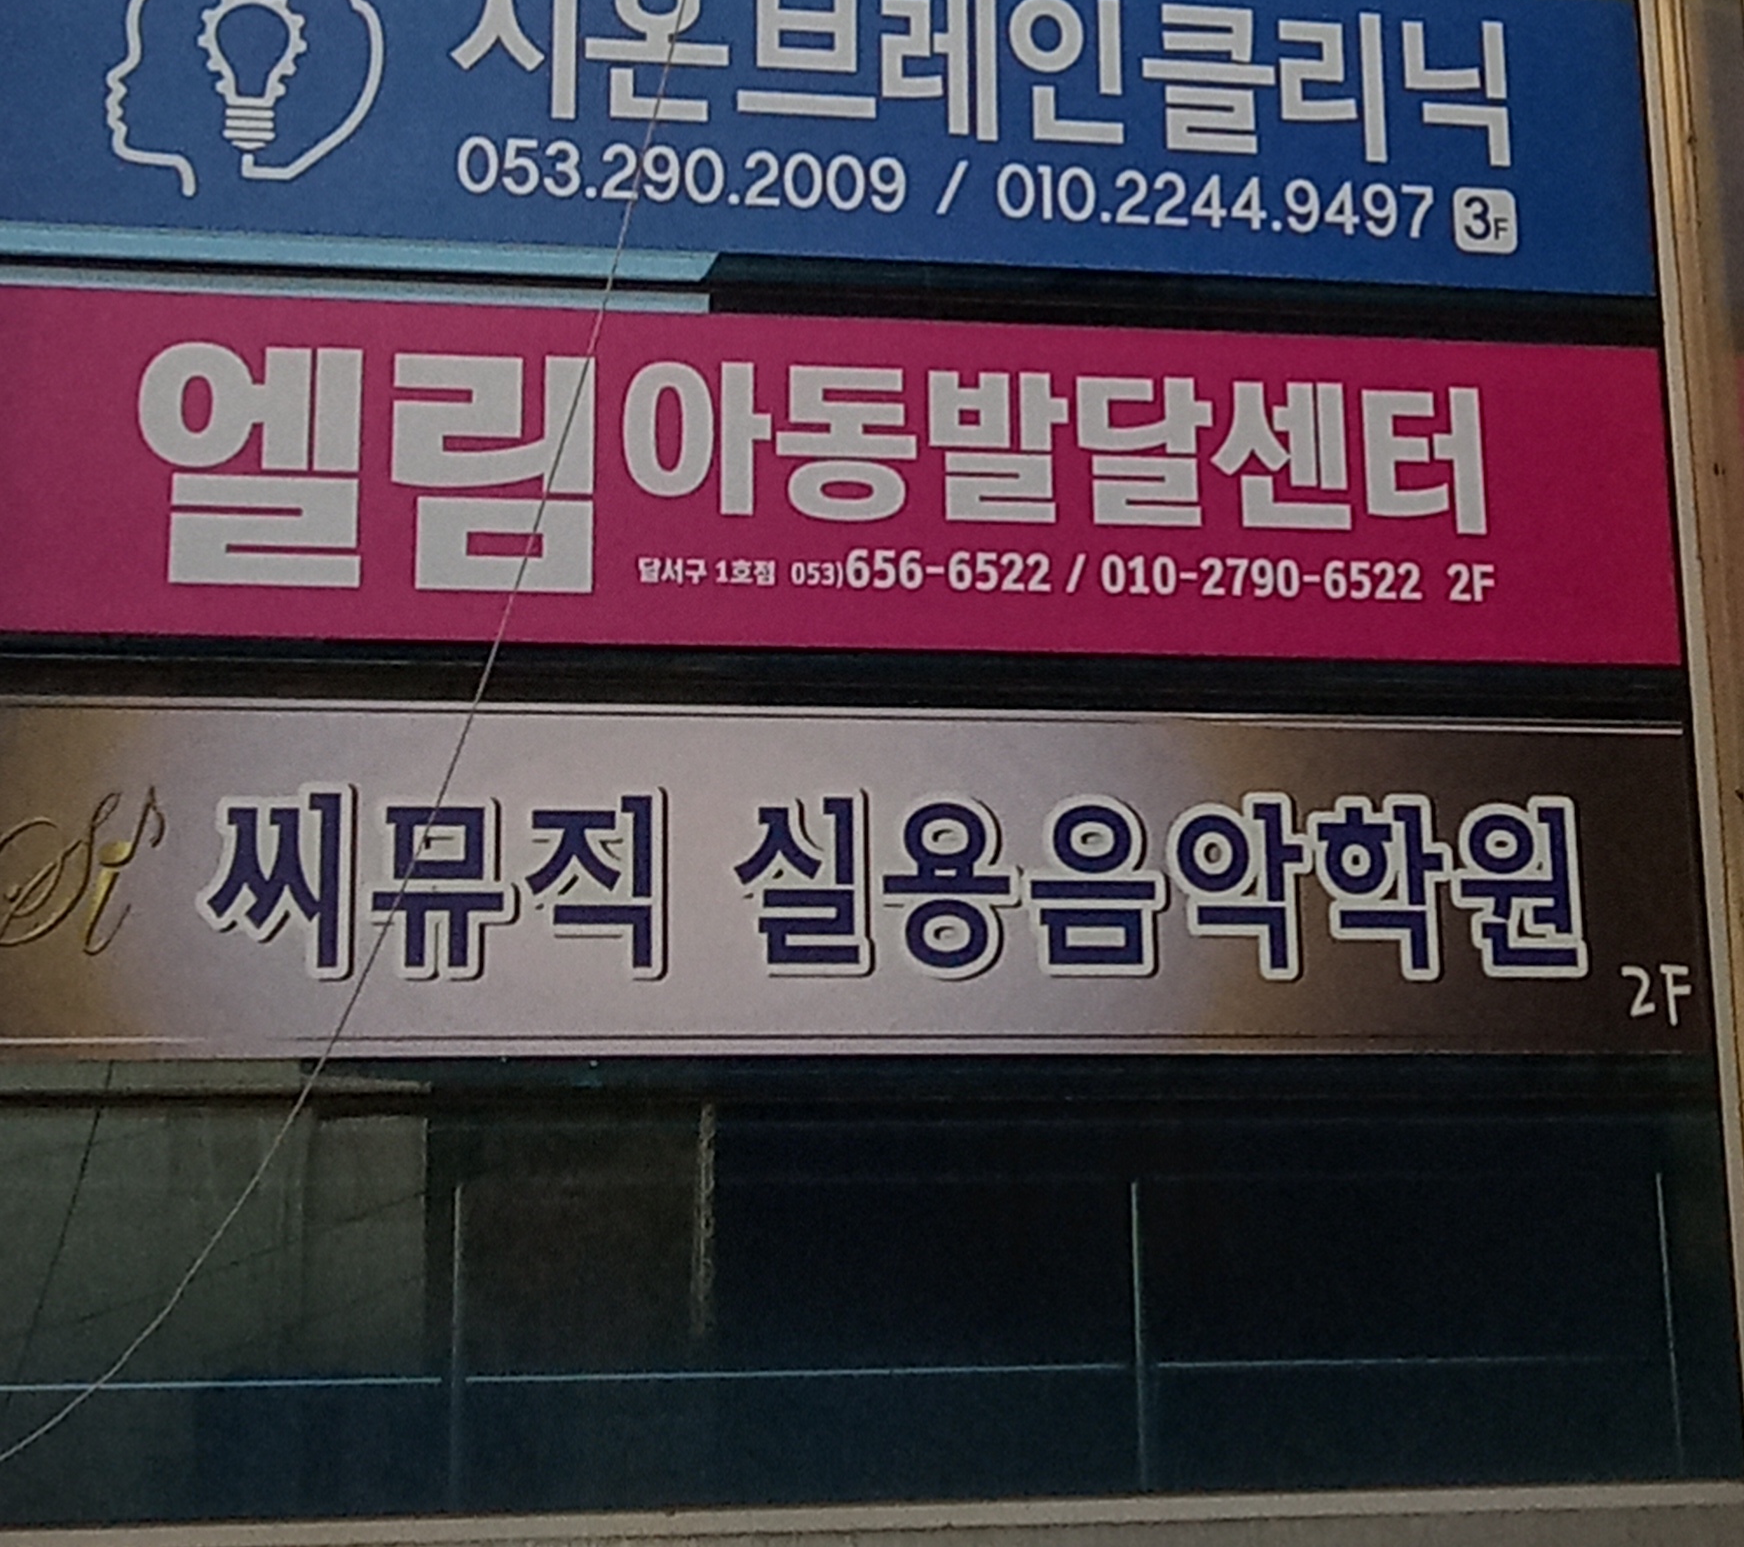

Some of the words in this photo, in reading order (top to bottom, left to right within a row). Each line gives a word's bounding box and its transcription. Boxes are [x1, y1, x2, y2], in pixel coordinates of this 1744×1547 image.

[457, 135, 908, 213] 053.290.2009
[996, 164, 1435, 240] 010.2244.9497
[1465, 195, 1510, 243] 3F
[637, 557, 707, 585] 달서구
[715, 559, 776, 587] 1호점
[1100, 555, 1423, 603] 010-2790-6522
[1446, 563, 1497, 603] 2F
[206, 791, 656, 971] 씨뮤직
[734, 797, 1580, 973] 실용음악학원
[1619, 964, 1692, 1027] 2F
